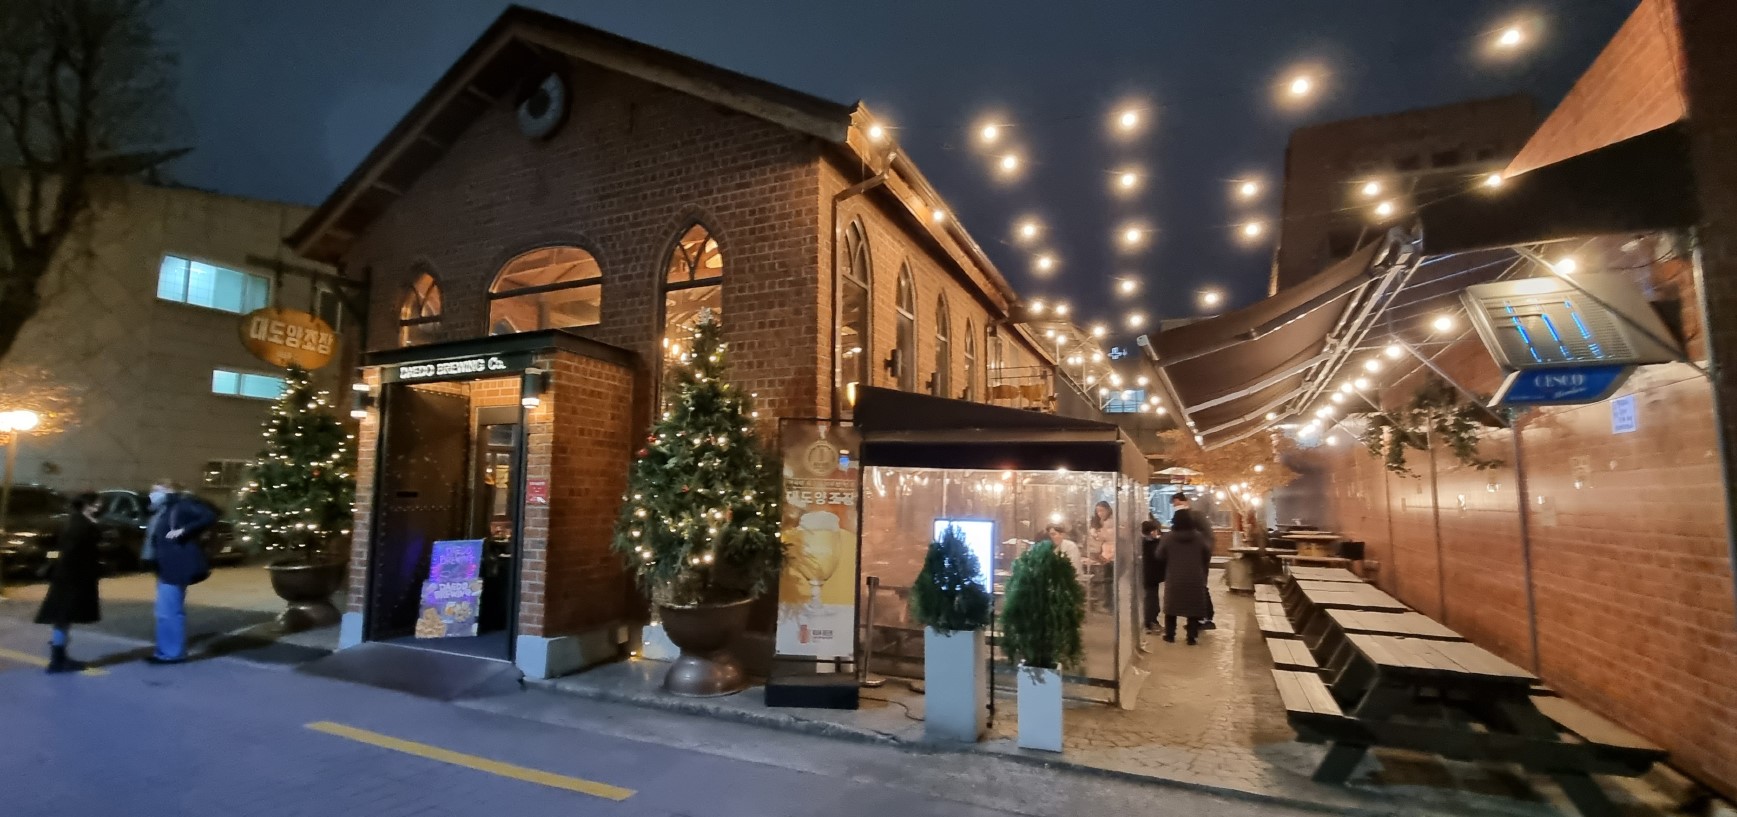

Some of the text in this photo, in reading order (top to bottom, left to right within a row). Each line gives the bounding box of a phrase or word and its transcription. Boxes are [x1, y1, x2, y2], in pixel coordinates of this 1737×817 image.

[250, 316, 335, 356] 대도양조장
[399, 364, 435, 379] DAEDO
[437, 358, 486, 375] BREWING
[1534, 374, 1584, 387] CESCO
